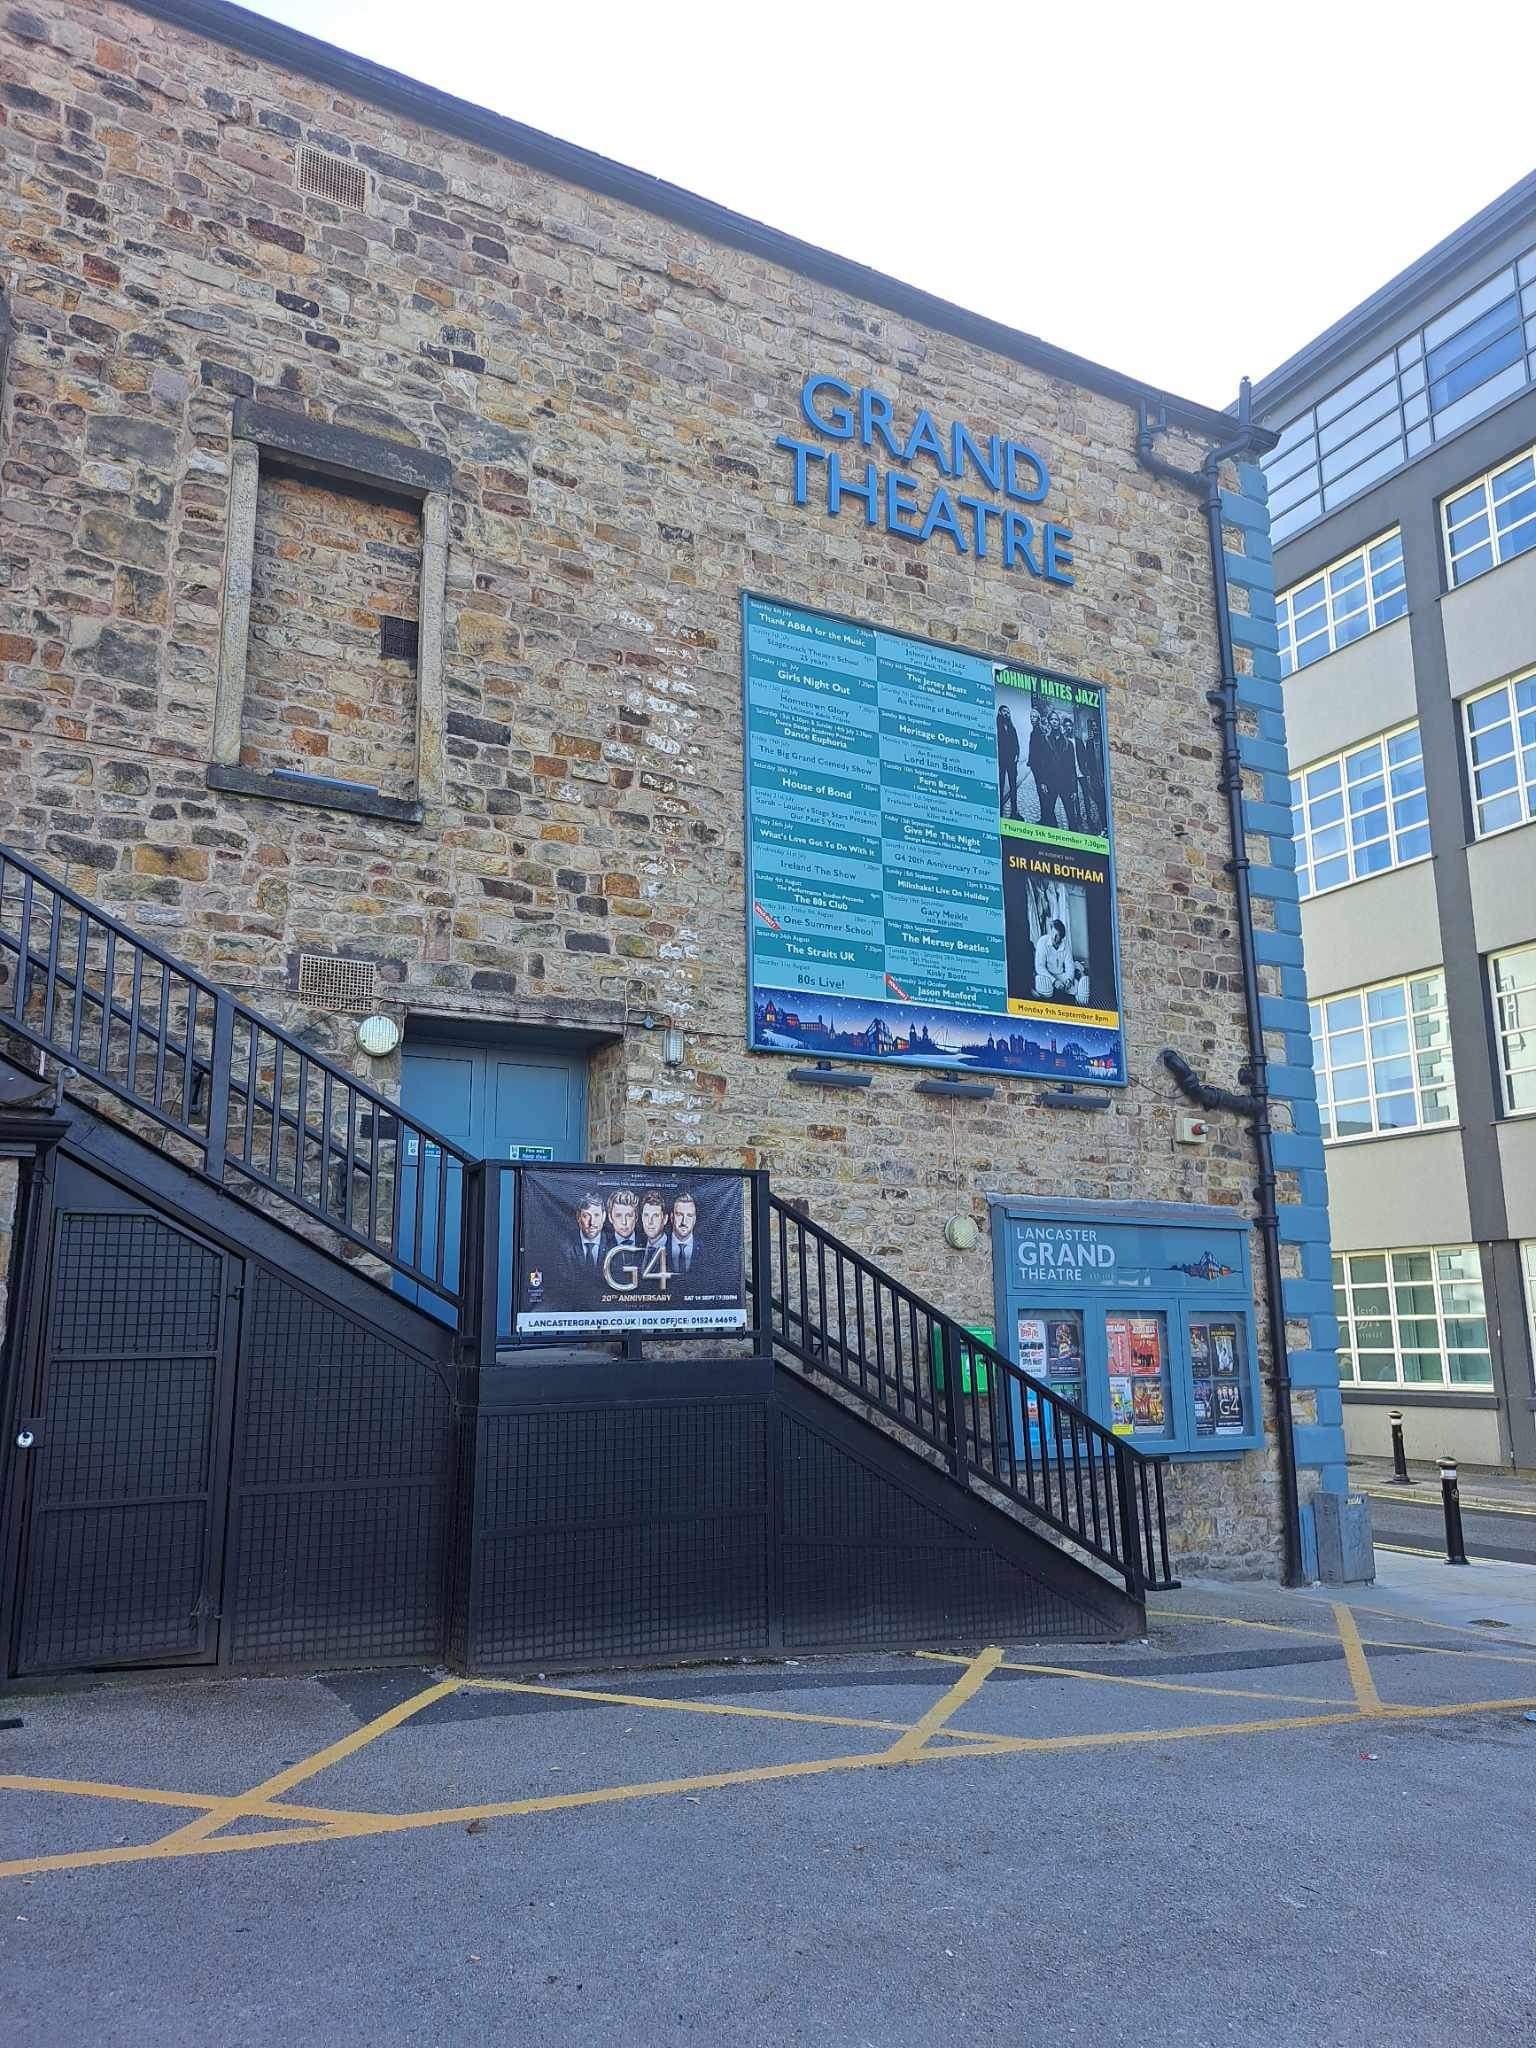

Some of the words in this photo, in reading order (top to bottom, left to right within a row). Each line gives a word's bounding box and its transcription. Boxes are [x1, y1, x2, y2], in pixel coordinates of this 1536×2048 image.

[802, 374, 1050, 504] GRAND
[776, 436, 1076, 587] THEATRE
[759, 612, 785, 627] Thank
[787, 620, 812, 633] ABBA
[814, 627, 825, 637] for
[828, 630, 841, 641] the
[843, 634, 865, 647] Music
[951, 660, 966, 671] Jazz
[777, 668, 800, 683] Girls
[802, 675, 829, 692] Night
[832, 682, 851, 695] Out
[906, 672, 921, 683] The
[922, 676, 944, 690] Jersey
[946, 682, 967, 694] Beats
[996, 667, 1037, 692] JOHNNY
[1040, 678, 1072, 701] HATES
[1074, 687, 1099, 708] JAZZ
[780, 694, 826, 712] Hometown
[827, 704, 850, 718] Glory
[909, 699, 935, 713] Evening
[784, 727, 809, 740] Dance
[811, 733, 847, 750] Euphoria
[898, 723, 935, 741] Heritage
[937, 732, 960, 746] Open
[961, 738, 978, 751] Day
[758, 744, 774, 755] The
[776, 748, 789, 759] Big
[791, 751, 815, 763] Grand
[817, 757, 849, 771] Comedy
[850, 764, 872, 775] Show
[903, 753, 925, 766] Lord
[926, 758, 939, 769] Ian
[941, 761, 976, 777] Botham
[781, 776, 813, 792] House
[815, 783, 826, 794] of
[827, 785, 852, 800] Bond
[919, 776, 936, 786] Fern
[938, 780, 960, 793] Brady
[790, 812, 803, 821] Our
[759, 828, 786, 841] What's
[788, 833, 806, 844] Love
[808, 837, 823, 848] Got
[825, 840, 834, 850] To
[836, 842, 847, 852] Do
[848, 844, 867, 856] With
[868, 848, 875, 857] It
[903, 824, 922, 836] Give
[924, 828, 937, 839] Me
[939, 831, 956, 842] The
[958, 835, 980, 848] Night
[1004, 823, 1033, 836] Thursday
[1034, 829, 1045, 838] 5th
[1047, 831, 1082, 846] September
[1084, 839, 1106, 850] 7:30pm
[780, 859, 811, 872] Ireland
[814, 864, 831, 876] The
[832, 868, 856, 880] Show
[894, 853, 905, 862] G4
[908, 855, 924, 865] 20th
[926, 858, 970, 875] Anniversary
[972, 866, 990, 877] Tour
[1008, 855, 1027, 870] SIR
[1030, 859, 1050, 874] IAN
[1053, 863, 1104, 883] BOTHAM
[897, 879, 934, 893] Milkshake!
[935, 886, 950, 895] Live
[951, 888, 962, 897] On
[963, 890, 989, 903] Holiday
[794, 894, 810, 904] The
[812, 897, 826, 907] 80s
[828, 900, 848, 911] Club
[782, 914, 804, 926] One
[804, 917, 842, 931] Summer
[844, 924, 873, 936] School
[920, 906, 940, 918] Gary
[942, 909, 968, 922] Meikle
[785, 943, 804, 954] The
[807, 946, 837, 959] Straits
[839, 950, 855, 962] UK
[901, 932, 919, 944] The
[921, 935, 955, 950] Mersey
[956, 940, 989, 954] Beatles
[796, 973, 815, 985] 80s
[818, 976, 845, 990] Live!
[917, 986, 940, 998] Jason
[942, 989, 977, 1001] Manford
[1018, 1004, 1043, 1015] Monday
[1057, 1009, 1092, 1021] September
[1094, 1013, 1108, 1023] 8pm
[1016, 1227, 1097, 1242] LANCASTER
[1018, 1241, 1116, 1268] GRAND
[603, 1244, 682, 1292] G4
[1019, 1266, 1082, 1281] THEATRE
[618, 1294, 672, 1302] ANNIVERSARY
[528, 1318, 637, 1328] LANCASTERGRAND.CO.UK
[642, 1318, 659, 1326] BOX
[660, 1316, 690, 1326] OFFICE:
[692, 1316, 714, 1325] 01524
[715, 1316, 738, 1324] 64695
[1219, 1398, 1240, 1416] G4
